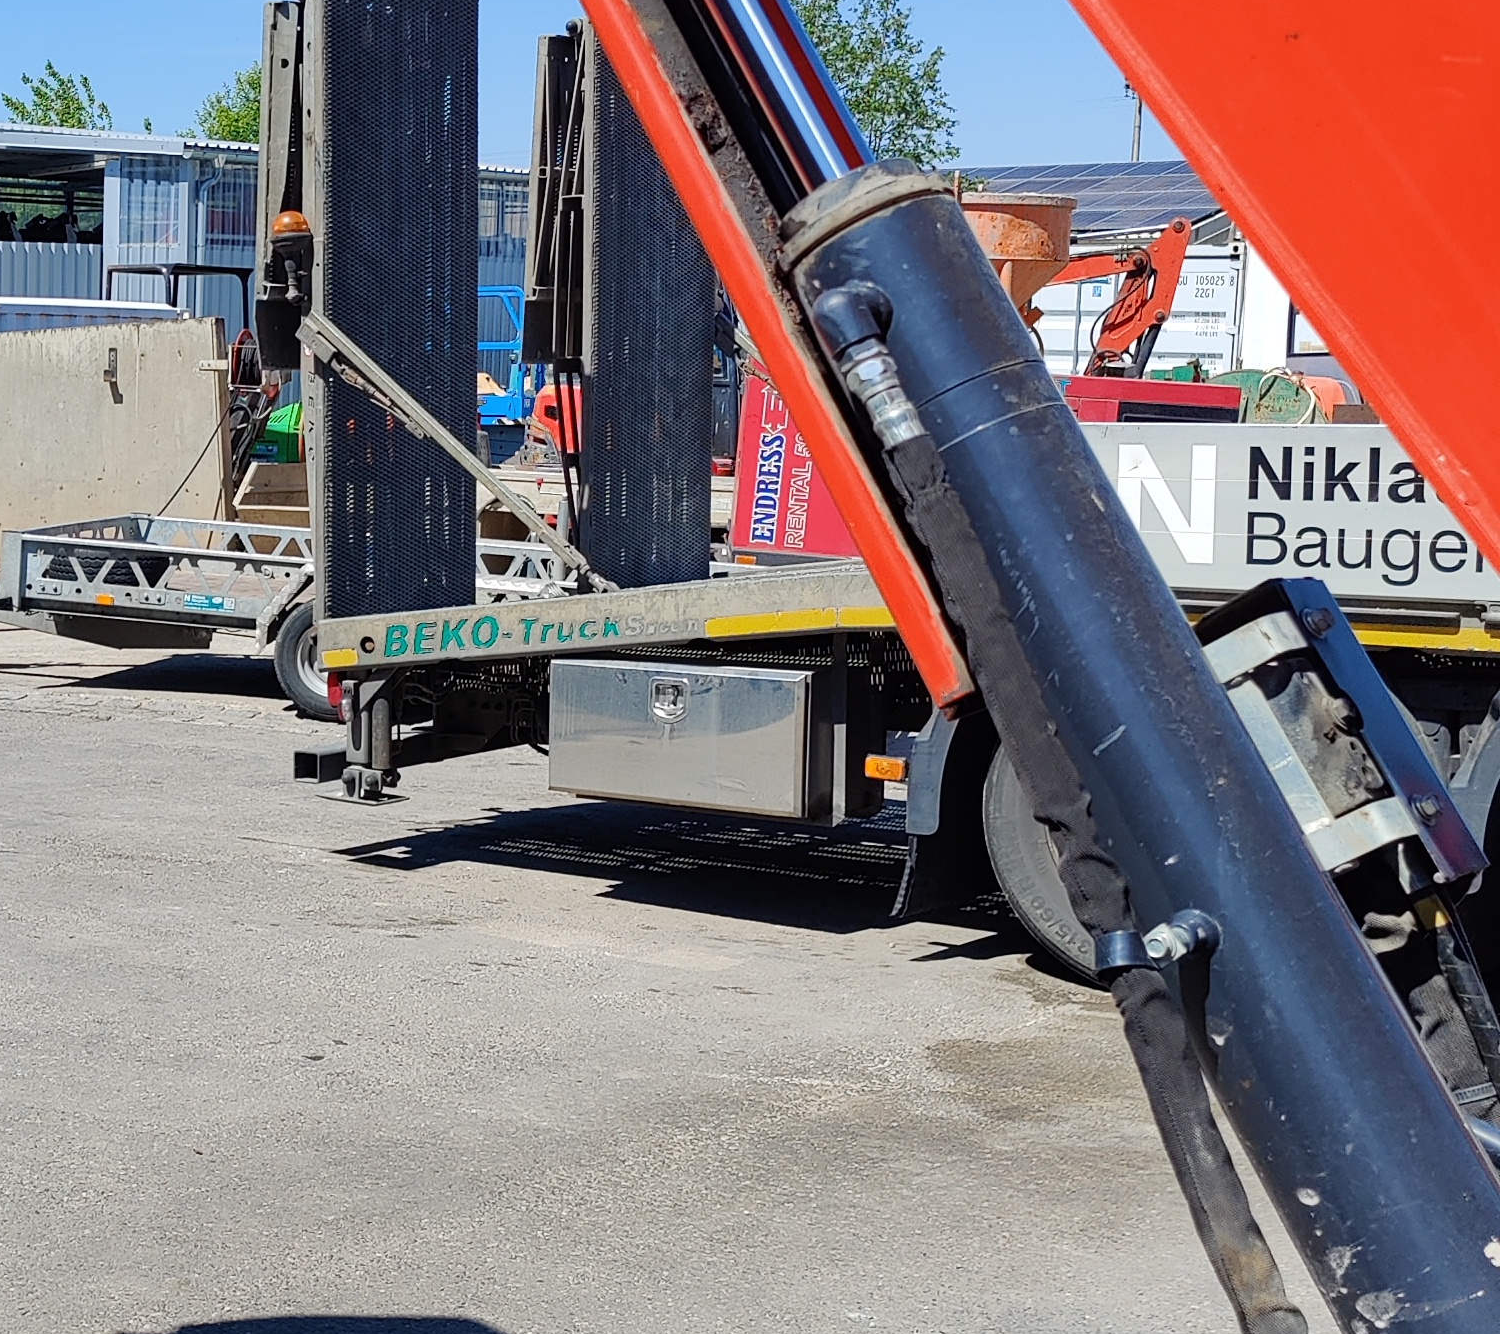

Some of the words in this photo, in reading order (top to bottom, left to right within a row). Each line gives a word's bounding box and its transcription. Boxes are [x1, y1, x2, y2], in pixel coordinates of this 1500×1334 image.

[1194, 287, 1215, 298] 22G1
[1195, 275, 1225, 287] 105025
[1229, 275, 1235, 286] 8
[750, 433, 787, 545] ENDRESS
[784, 460, 813, 549] RENTAL
[1117, 443, 1218, 564] N
[1248, 445, 1444, 504] Nikla
